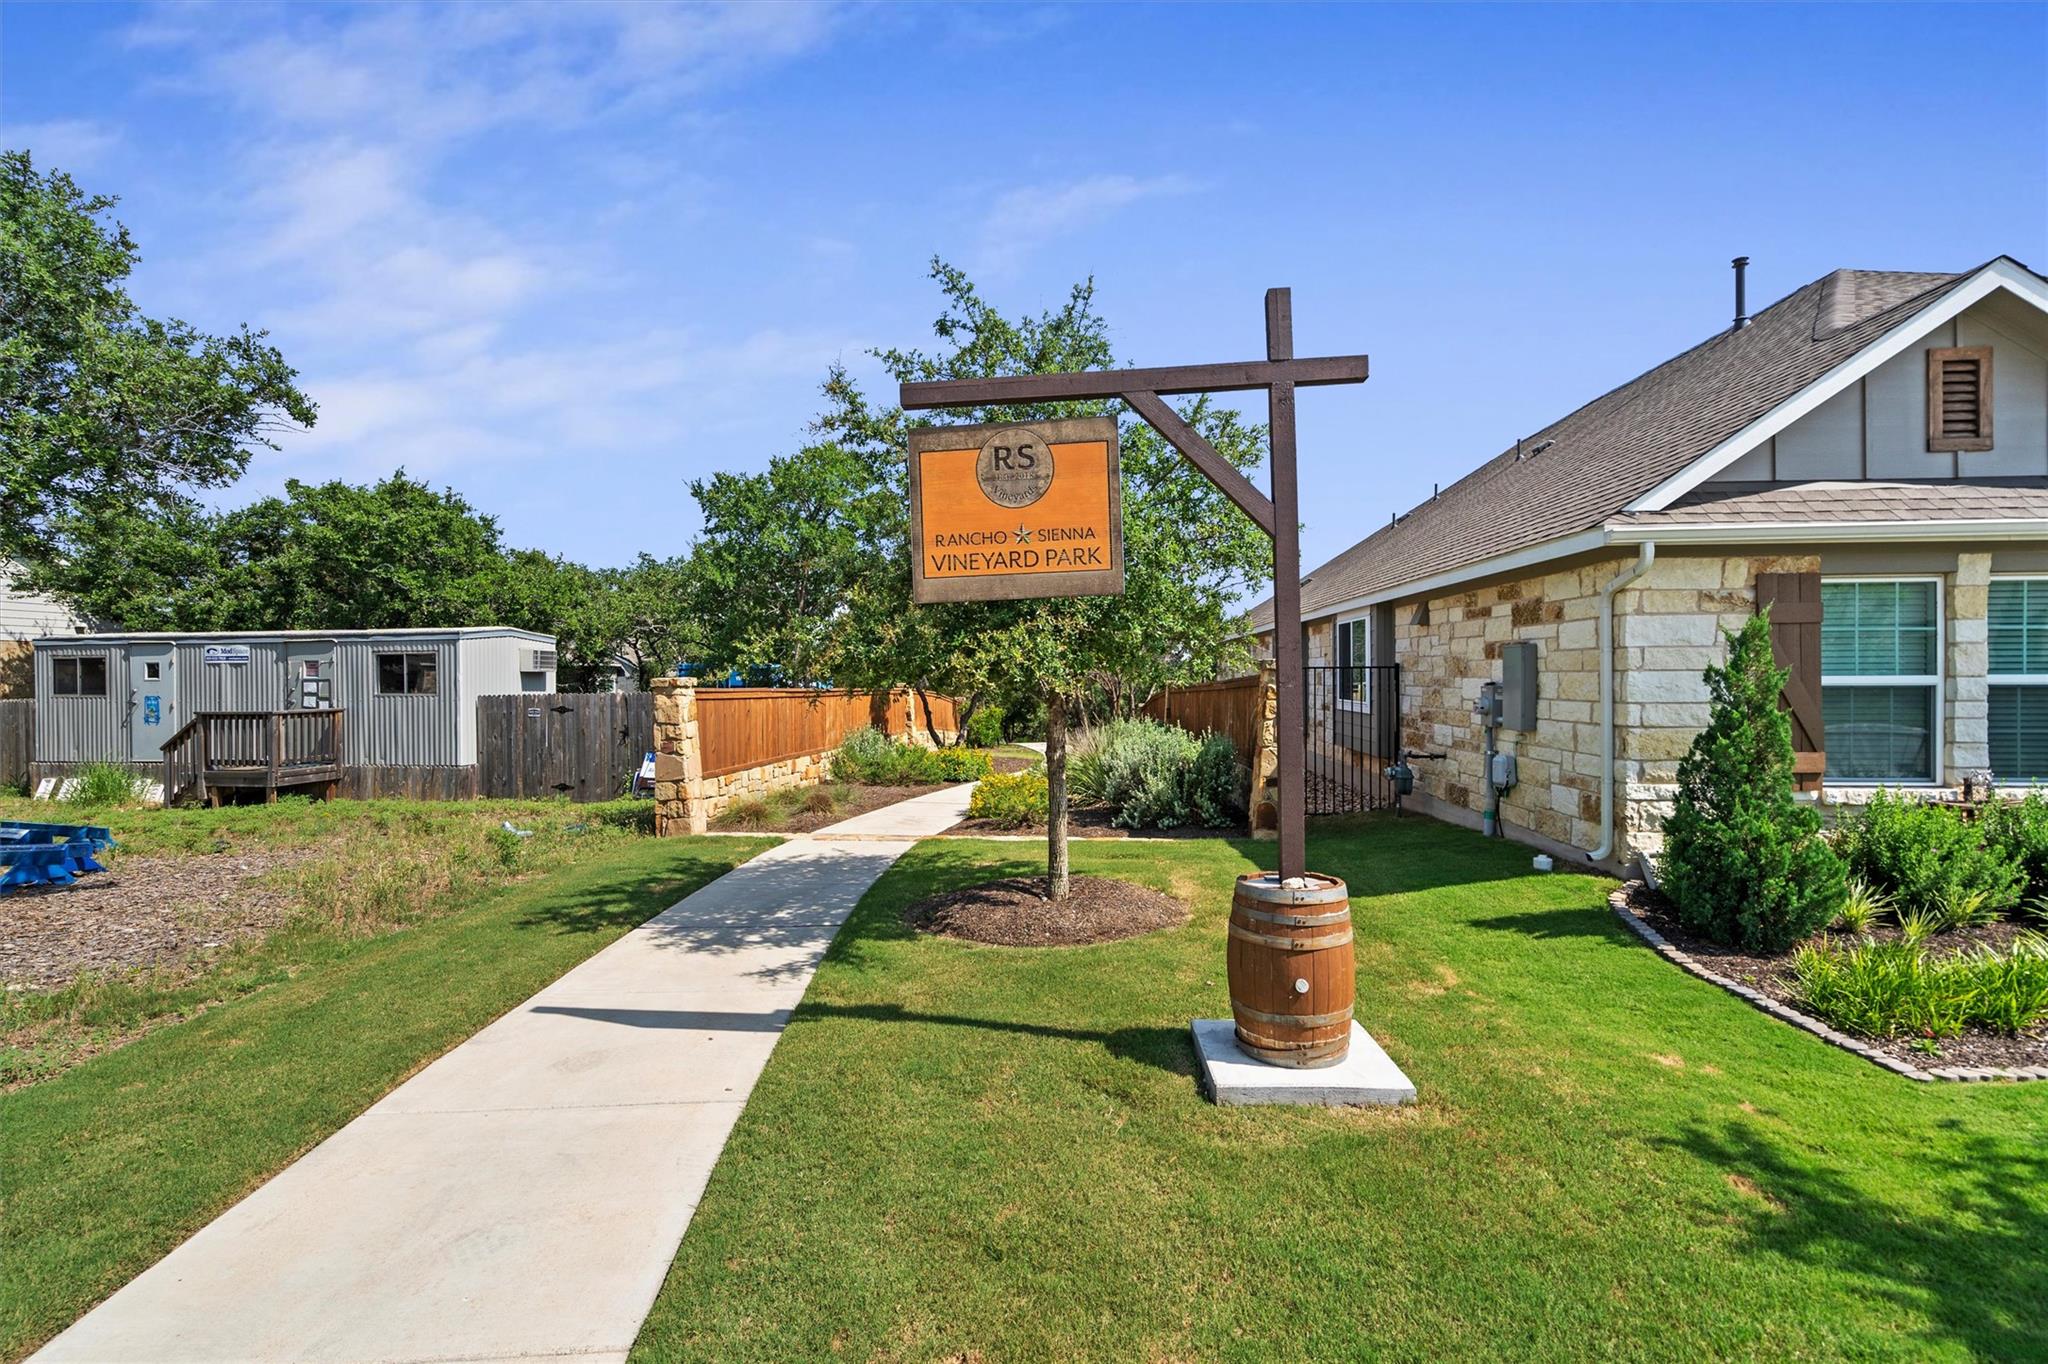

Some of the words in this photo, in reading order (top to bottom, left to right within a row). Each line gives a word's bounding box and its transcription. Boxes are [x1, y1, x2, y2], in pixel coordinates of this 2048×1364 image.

[993, 444, 1035, 471] RS
[993, 484, 1039, 503] Vineyards
[935, 531, 1007, 547] RANCHO
[1038, 527, 1096, 542] SIENNA
[931, 550, 1039, 571] VINEYARD
[1045, 546, 1103, 567] PARK
